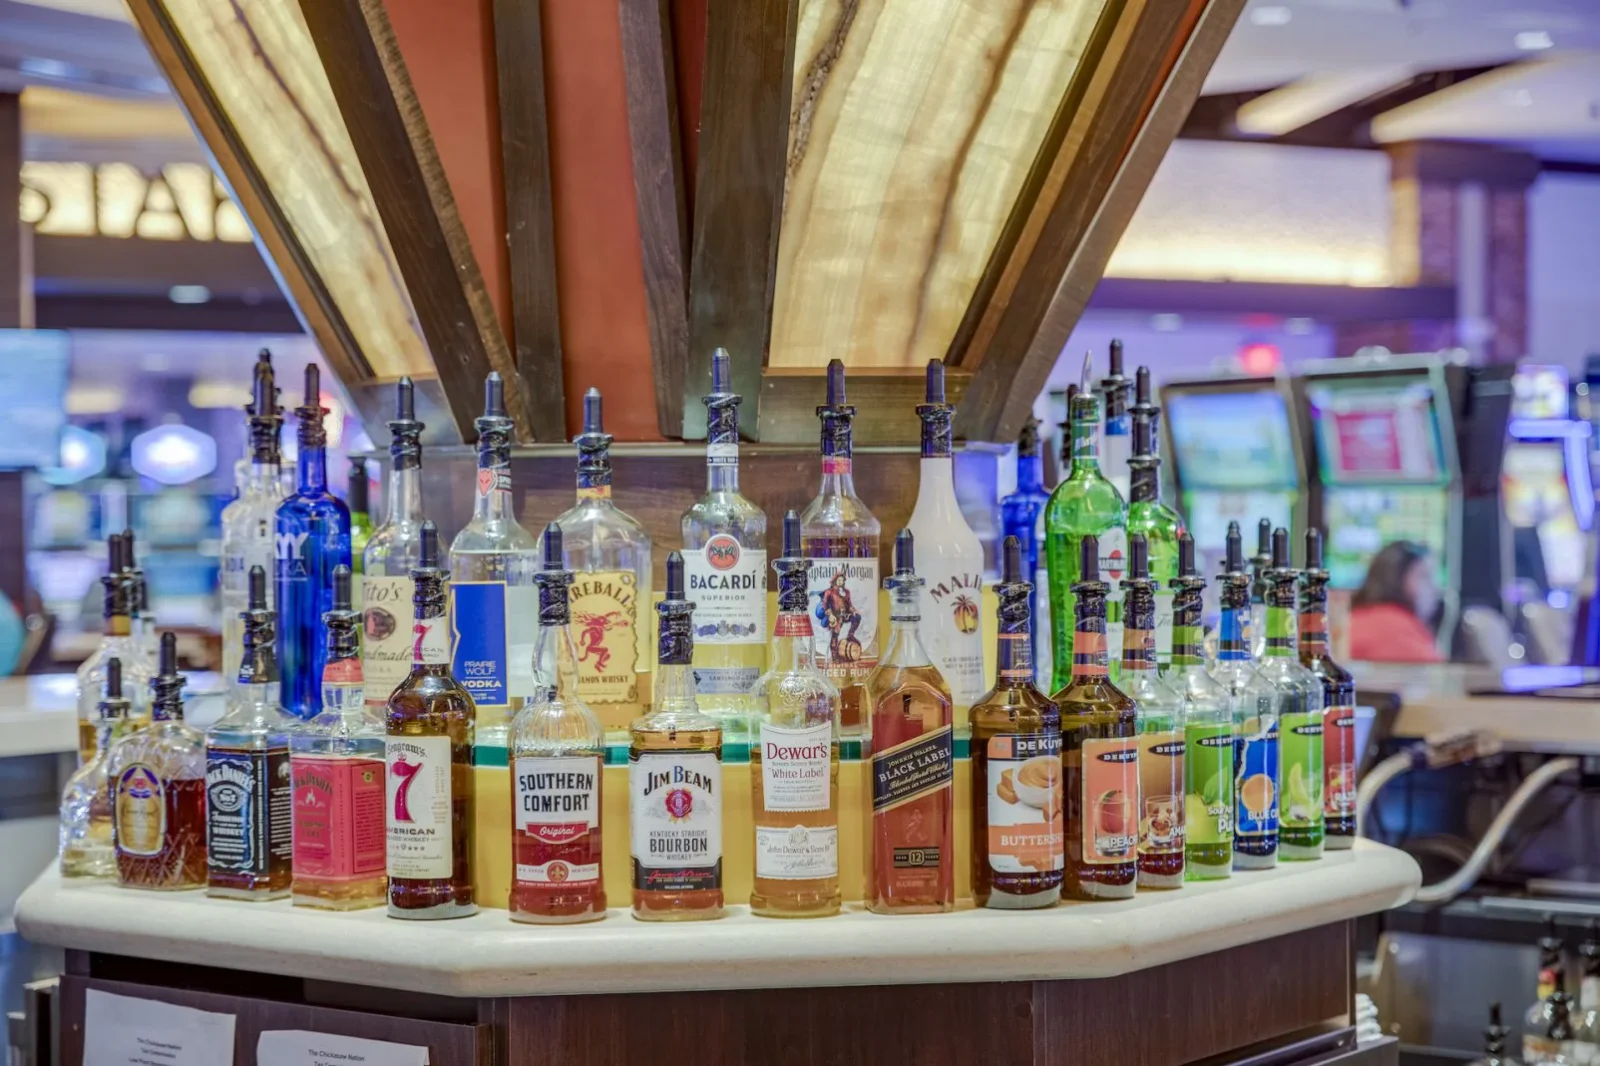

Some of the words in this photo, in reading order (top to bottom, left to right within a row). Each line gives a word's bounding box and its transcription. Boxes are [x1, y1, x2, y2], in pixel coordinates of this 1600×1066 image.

[690, 570, 756, 589] BACARDÍ
[808, 562, 837, 583] aptain
[840, 561, 873, 581] Morgan
[570, 580, 631, 608] REBALL
[464, 666, 496, 675] WOLF
[822, 668, 847, 678] ICED
[850, 668, 870, 677] RUM
[460, 680, 502, 688] VODKA
[766, 742, 828, 760] Dewar's
[878, 761, 916, 783] BLACK
[916, 747, 952, 768] LABEL
[519, 773, 594, 792] SOUTHERN
[643, 770, 671, 797] JIM
[673, 765, 713, 796] BEAM
[391, 760, 424, 824] 7
[524, 794, 589, 812] COMFORT
[540, 826, 575, 837] Original
[649, 837, 708, 853] BOURBON
[911, 852, 921, 863] 12
[347, 1053, 365, 1062] Nation
